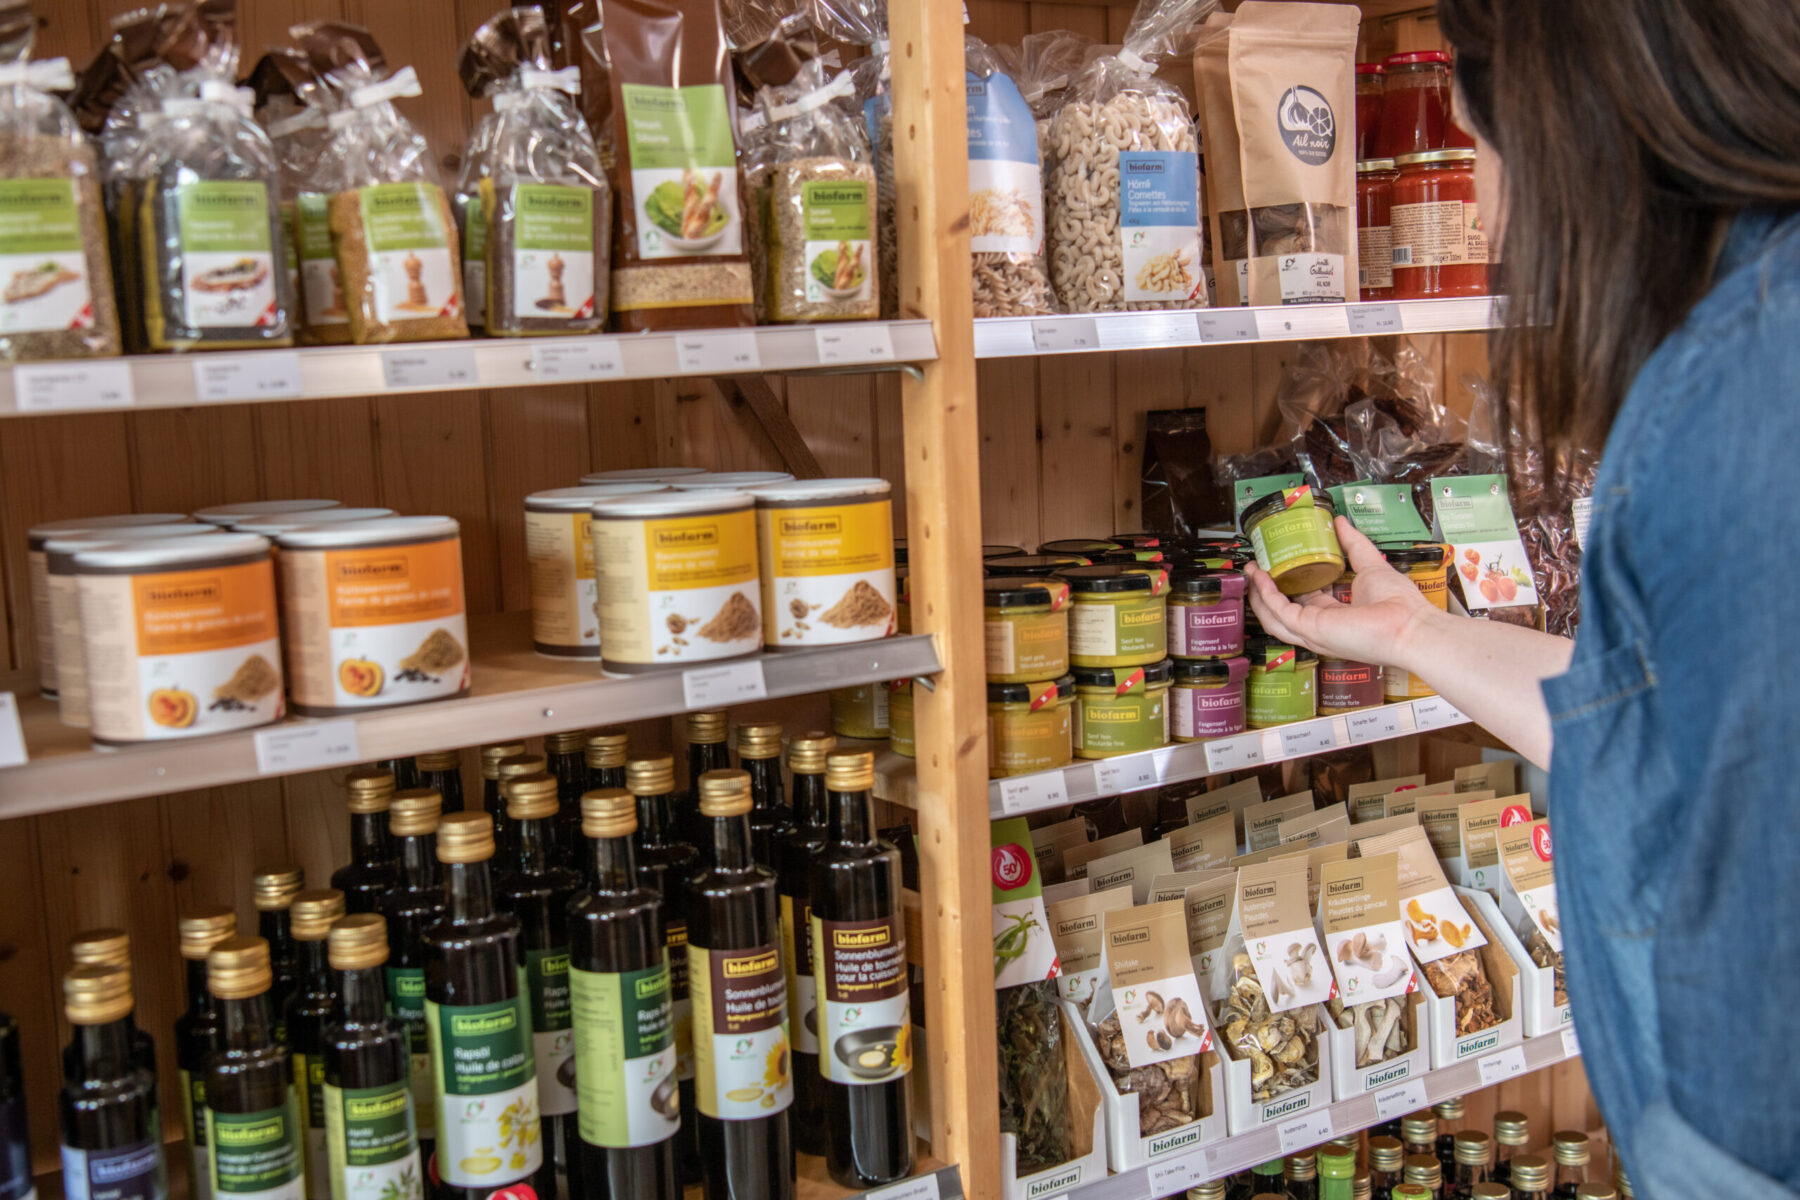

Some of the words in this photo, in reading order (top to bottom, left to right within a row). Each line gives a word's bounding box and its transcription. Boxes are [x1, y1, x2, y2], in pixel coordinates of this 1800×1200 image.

[1292, 135, 1308, 147] Ail
[1310, 138, 1330, 150] noir
[1129, 163, 1162, 172] biofarm
[784, 522, 837, 532] biofarm
[1269, 521, 1312, 538] biofarm
[659, 532, 714, 543] biofarm
[1124, 611, 1161, 624] biofarm
[1194, 615, 1236, 625] biofarm
[1325, 672, 1367, 681] biofarm
[1202, 696, 1241, 707] biofarm
[1090, 709, 1136, 720] biofarm
[1196, 804, 1227, 819] biofarm
[1425, 812, 1458, 821] biofarm
[1253, 816, 1282, 829] biofarm
[1469, 818, 1498, 829] biofarm
[1171, 843, 1200, 858] biofarm
[1505, 842, 1530, 853] biofarm
[1097, 872, 1131, 888] biofarm
[1245, 886, 1274, 897] biofarm
[1329, 881, 1361, 893] biofarm
[1192, 898, 1224, 914] biofarm
[1060, 919, 1094, 934] biofarm
[837, 933, 886, 945] biofarm
[1113, 931, 1147, 944] biofarm
[835, 961, 859, 972] Huile
[861, 961, 873, 972] de
[836, 973, 856, 983] pour
[726, 1002, 753, 1014] Huile
[1460, 1036, 1496, 1055] biofarm
[453, 1046, 491, 1060] Rapsöl
[455, 1062, 484, 1074] Huile
[1369, 1067, 1407, 1087] biofarm
[1266, 1098, 1307, 1118] biofarm
[1153, 1131, 1197, 1153] biofarm
[1031, 1173, 1077, 1196] biofarm
